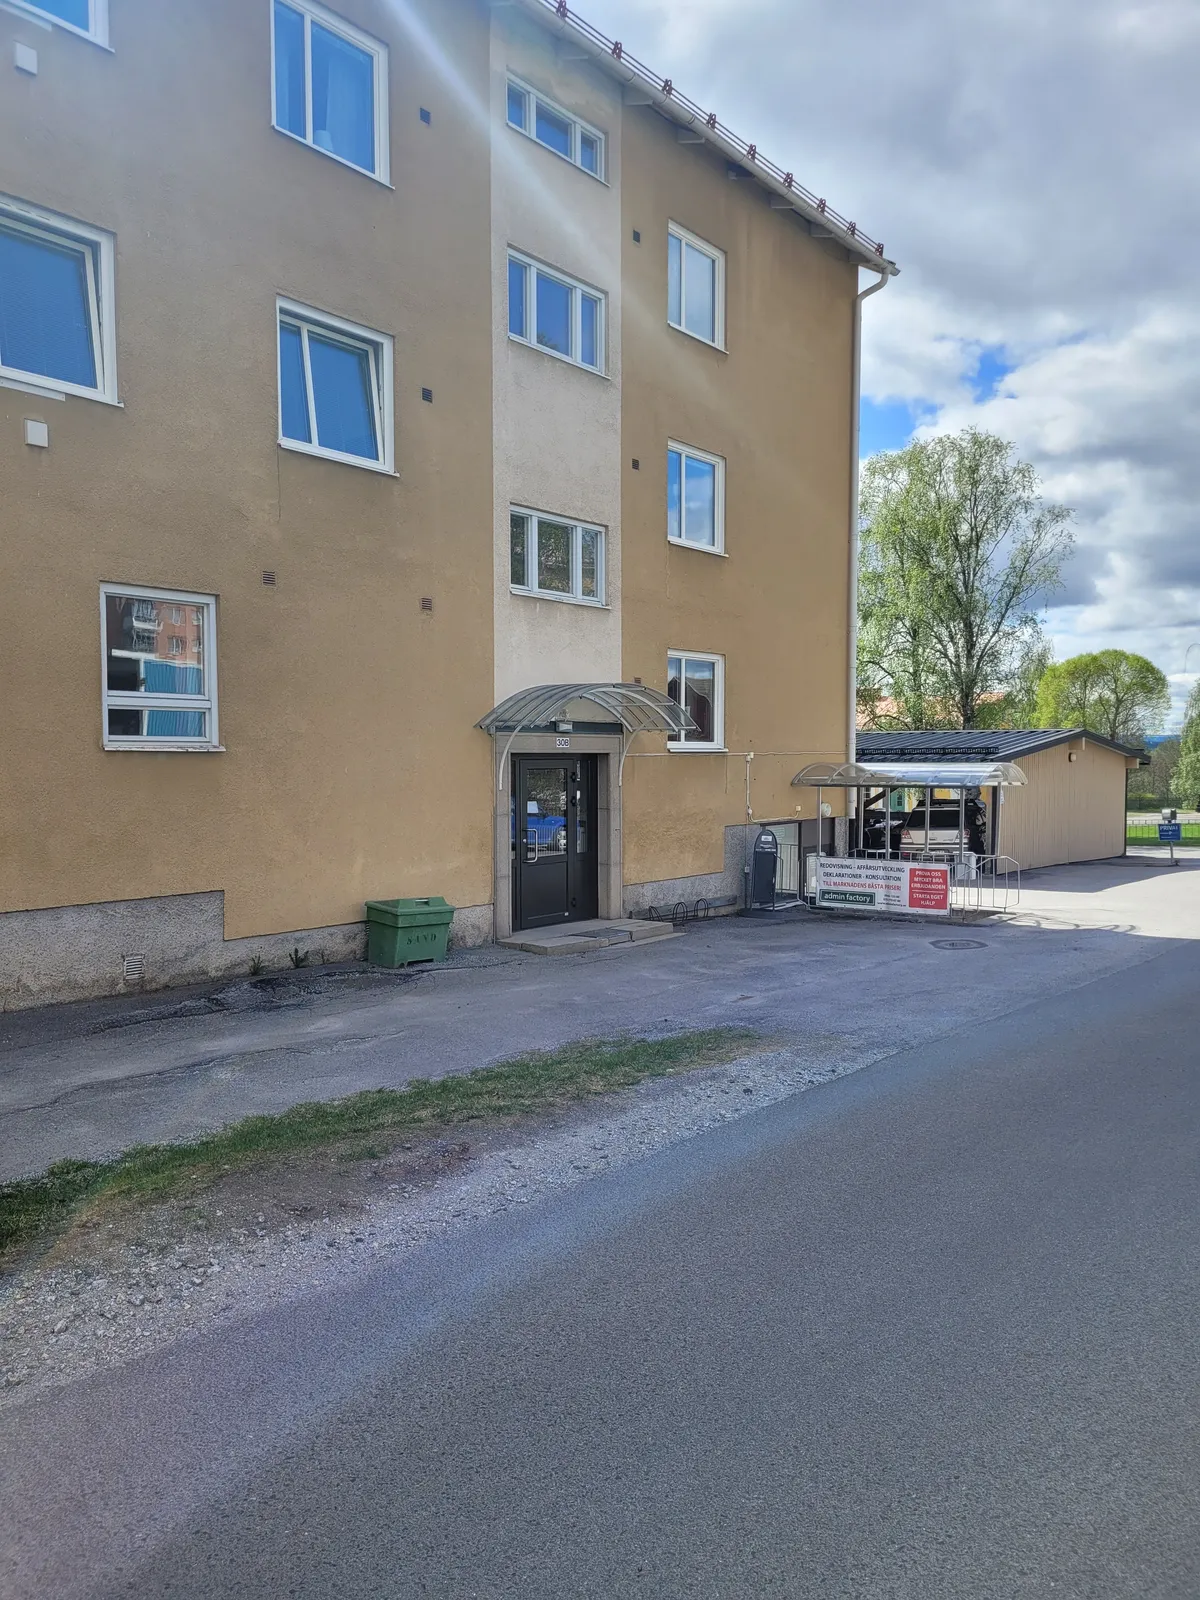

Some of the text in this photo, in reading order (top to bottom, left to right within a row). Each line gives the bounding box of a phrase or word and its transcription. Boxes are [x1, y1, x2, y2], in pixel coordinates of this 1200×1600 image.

[857, 864, 905, 872] AFFÄRSUTVECKLING
[846, 894, 870, 904] factory
[406, 934, 437, 945] SAND
